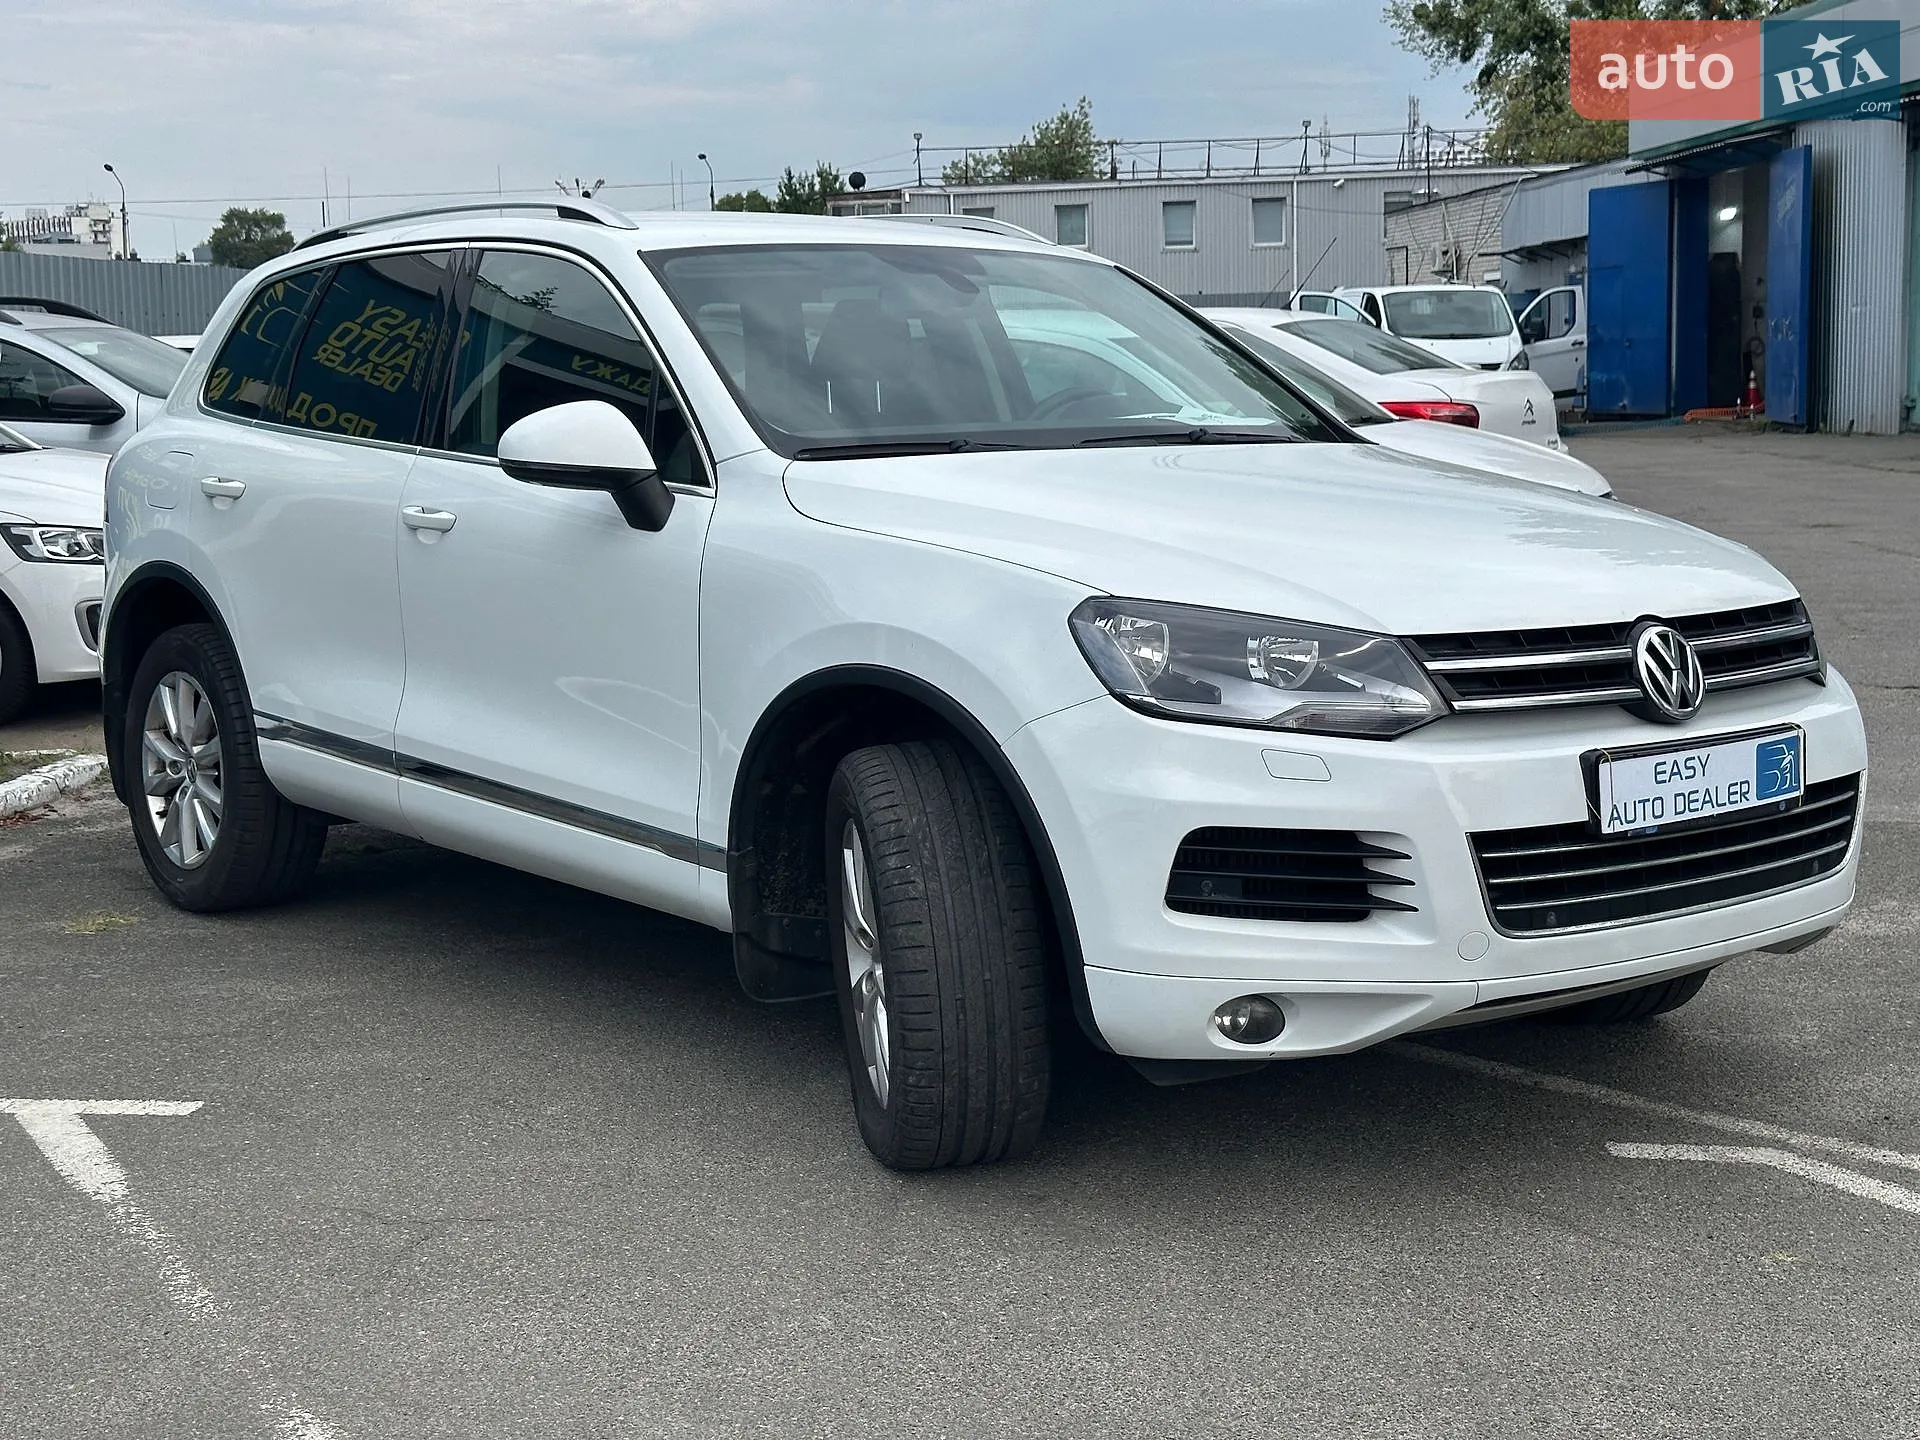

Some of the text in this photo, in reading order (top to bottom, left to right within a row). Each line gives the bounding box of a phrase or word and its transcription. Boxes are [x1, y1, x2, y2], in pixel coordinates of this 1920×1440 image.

[1654, 754, 1711, 785] EASY
[1607, 780, 1750, 828] AUTO DEALER
